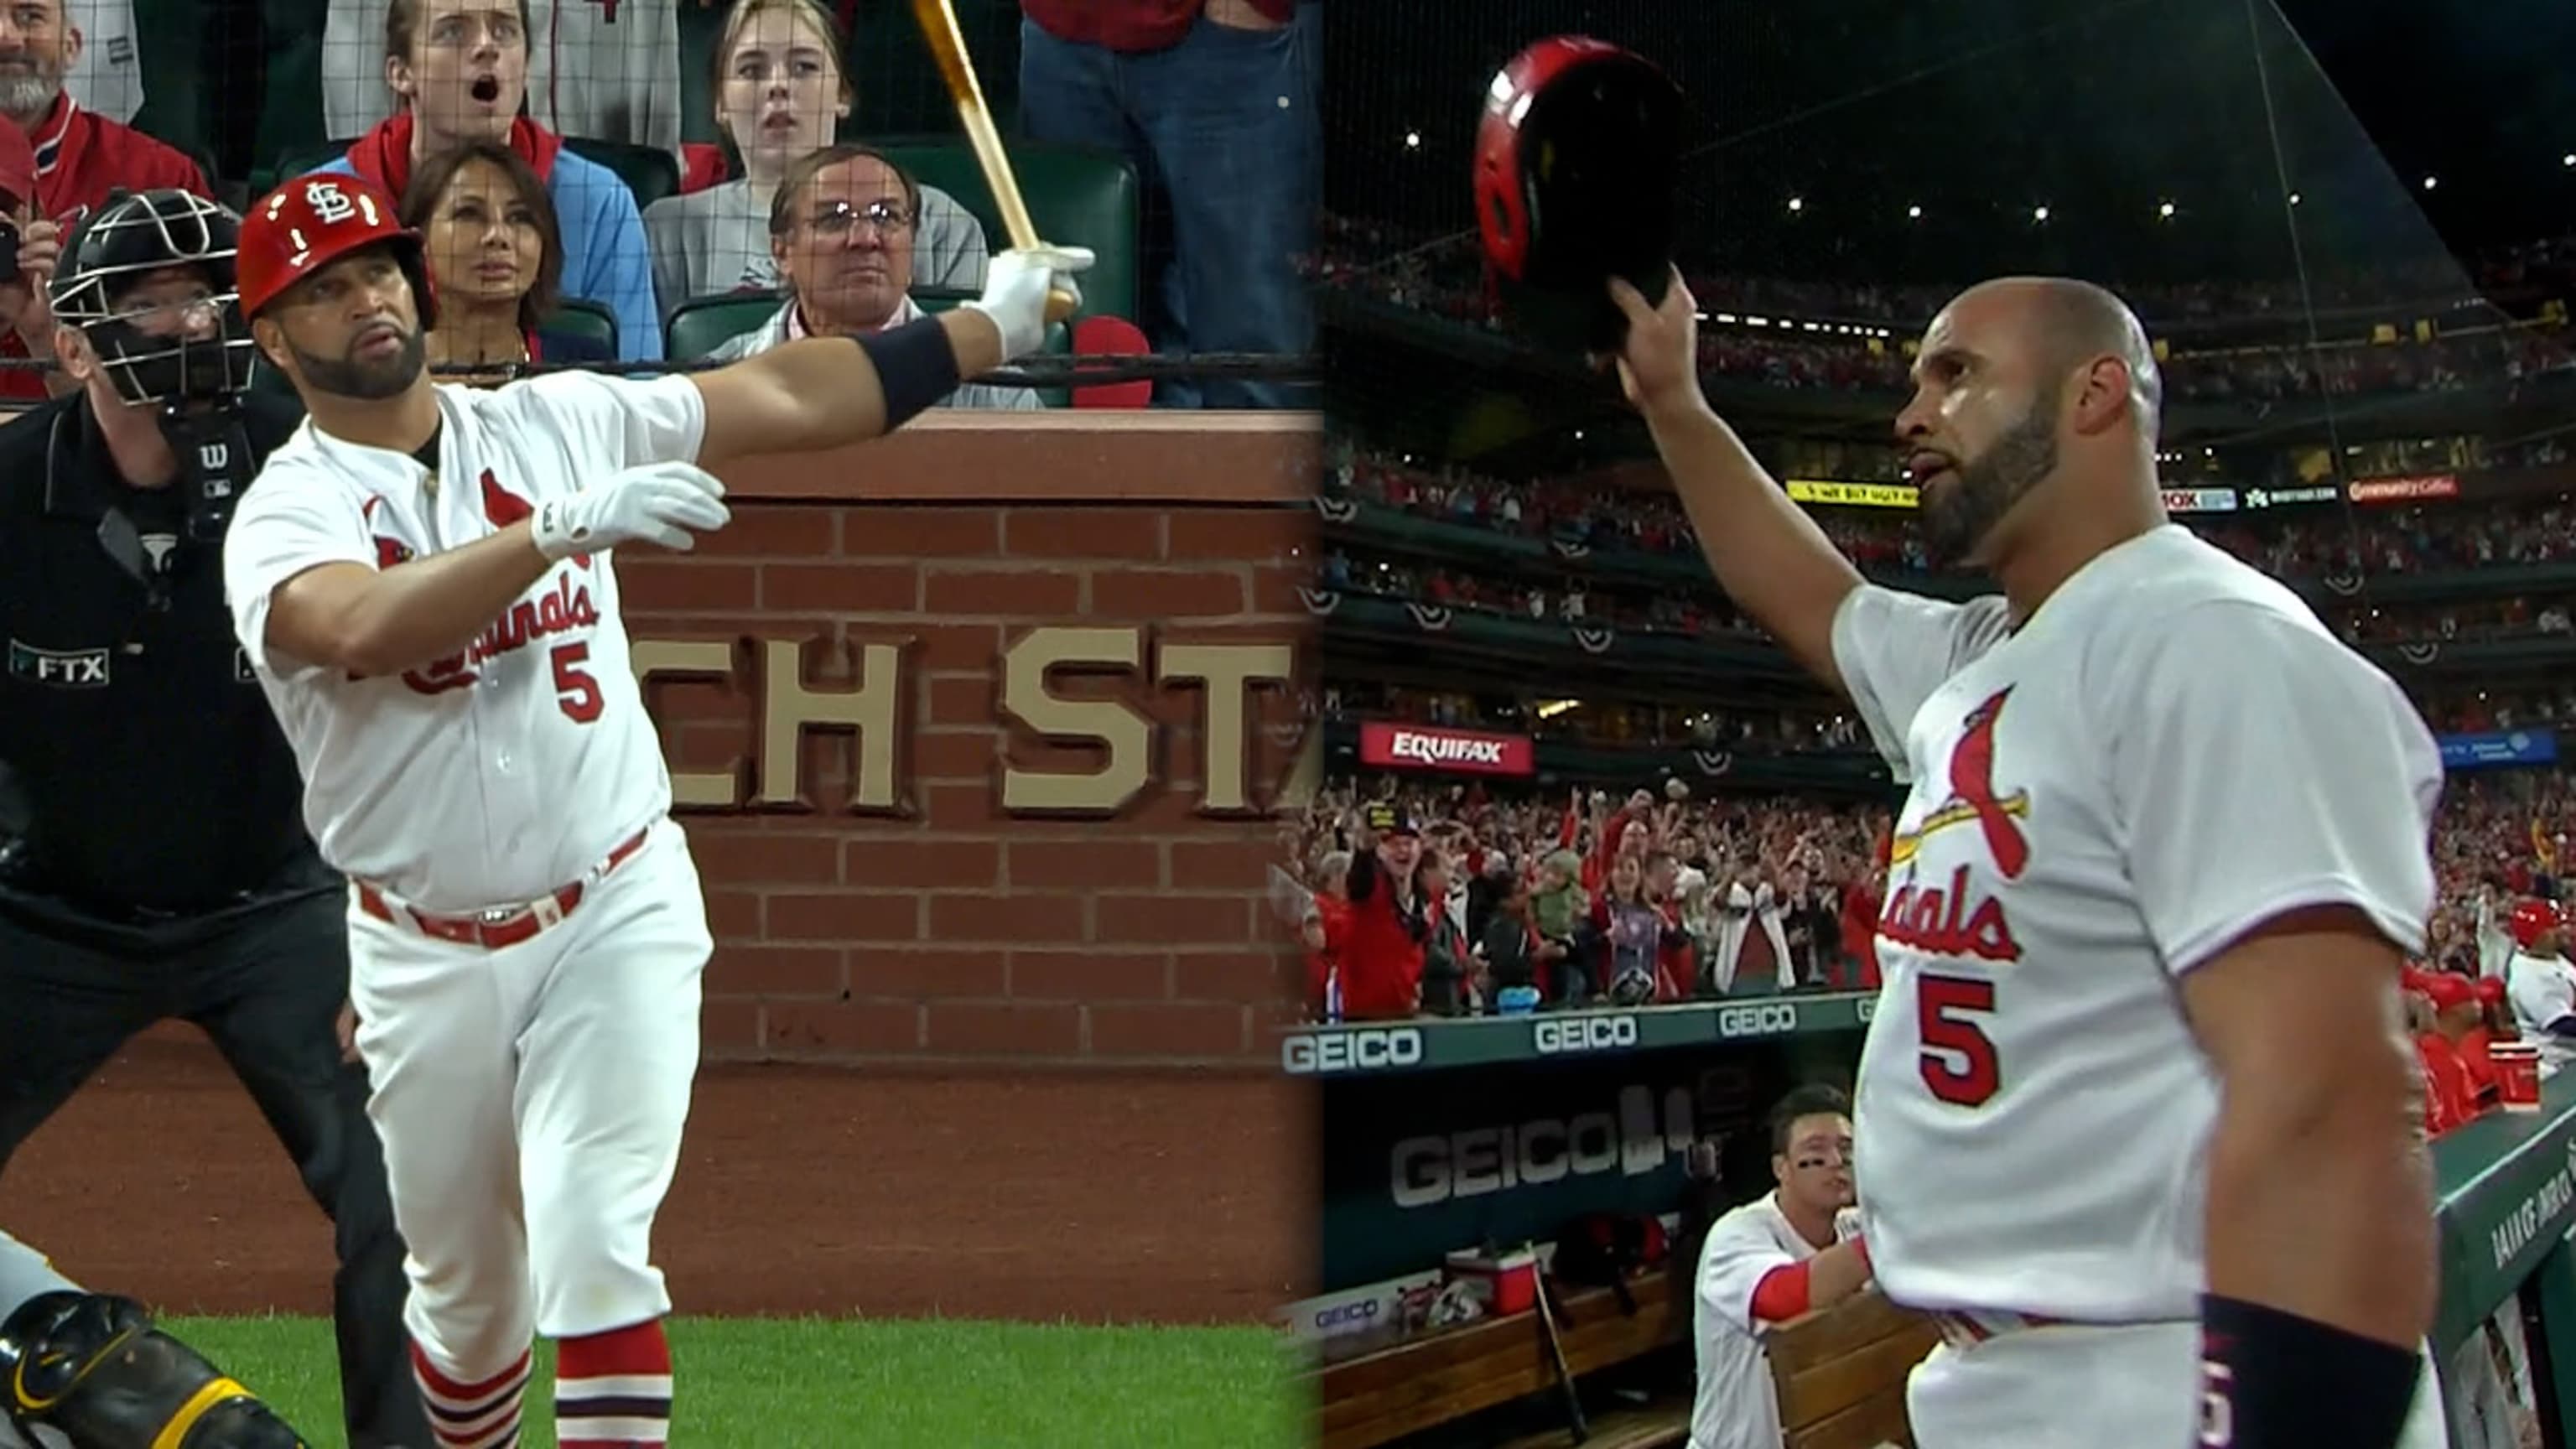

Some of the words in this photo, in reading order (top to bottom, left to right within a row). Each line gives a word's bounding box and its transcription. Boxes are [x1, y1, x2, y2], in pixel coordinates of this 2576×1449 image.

[38, 656, 105, 683] FTX
[550, 641, 605, 724] 5
[1392, 731, 1502, 764] EQUIFAX
[1281, 1028, 1423, 1074] GEICO
[1535, 1015, 1637, 1054] GEICO
[1719, 1004, 1797, 1037] GEICO
[1918, 973, 2000, 1107] 5
[1391, 1112, 1618, 1208] GEICO
[1315, 1298, 1379, 1328] GEICO
